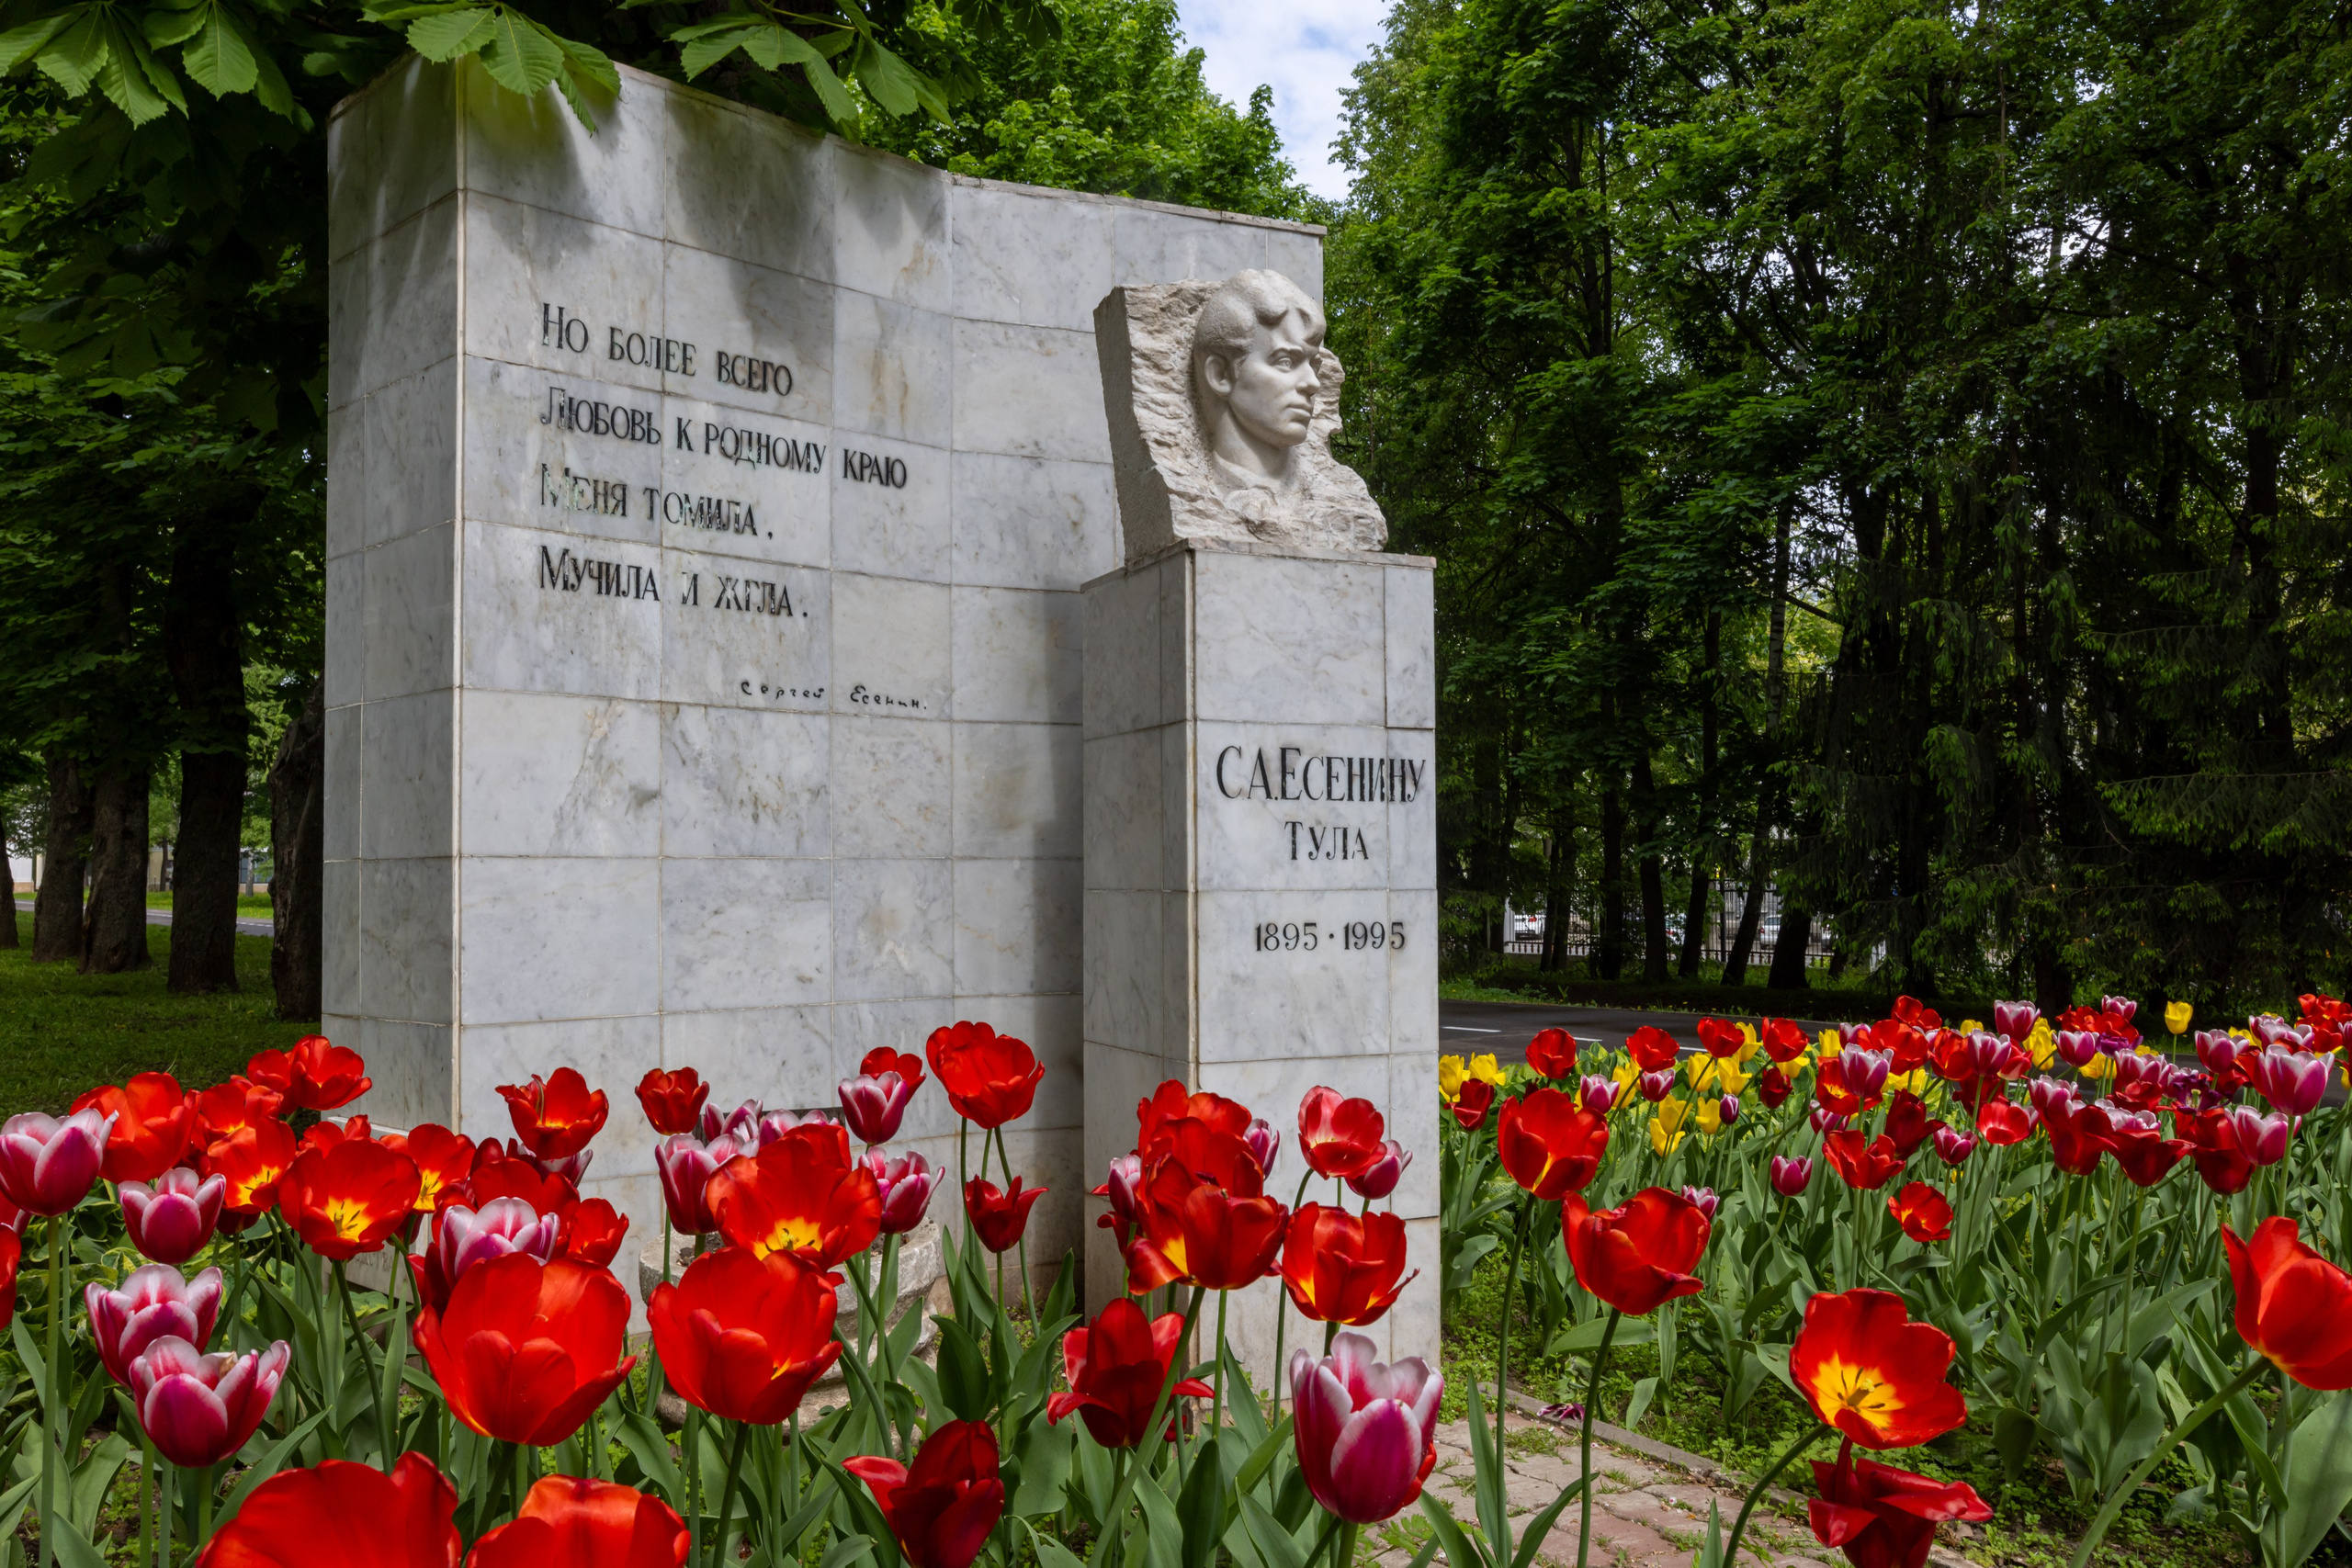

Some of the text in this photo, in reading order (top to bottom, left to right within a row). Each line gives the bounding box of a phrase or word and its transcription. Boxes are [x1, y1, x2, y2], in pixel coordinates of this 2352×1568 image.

[608, 326, 696, 377] БОЛЕЕ
[717, 351, 792, 396] ВСЕГО
[540, 387, 907, 488] ЛЮБОВЬ К РОДНОМУ КРАЮ
[540, 463, 628, 517] МЕНЯ
[540, 546, 661, 602] МУЧИЛА
[681, 571, 699, 606] И
[1283, 821, 1369, 861] ТУЛА
